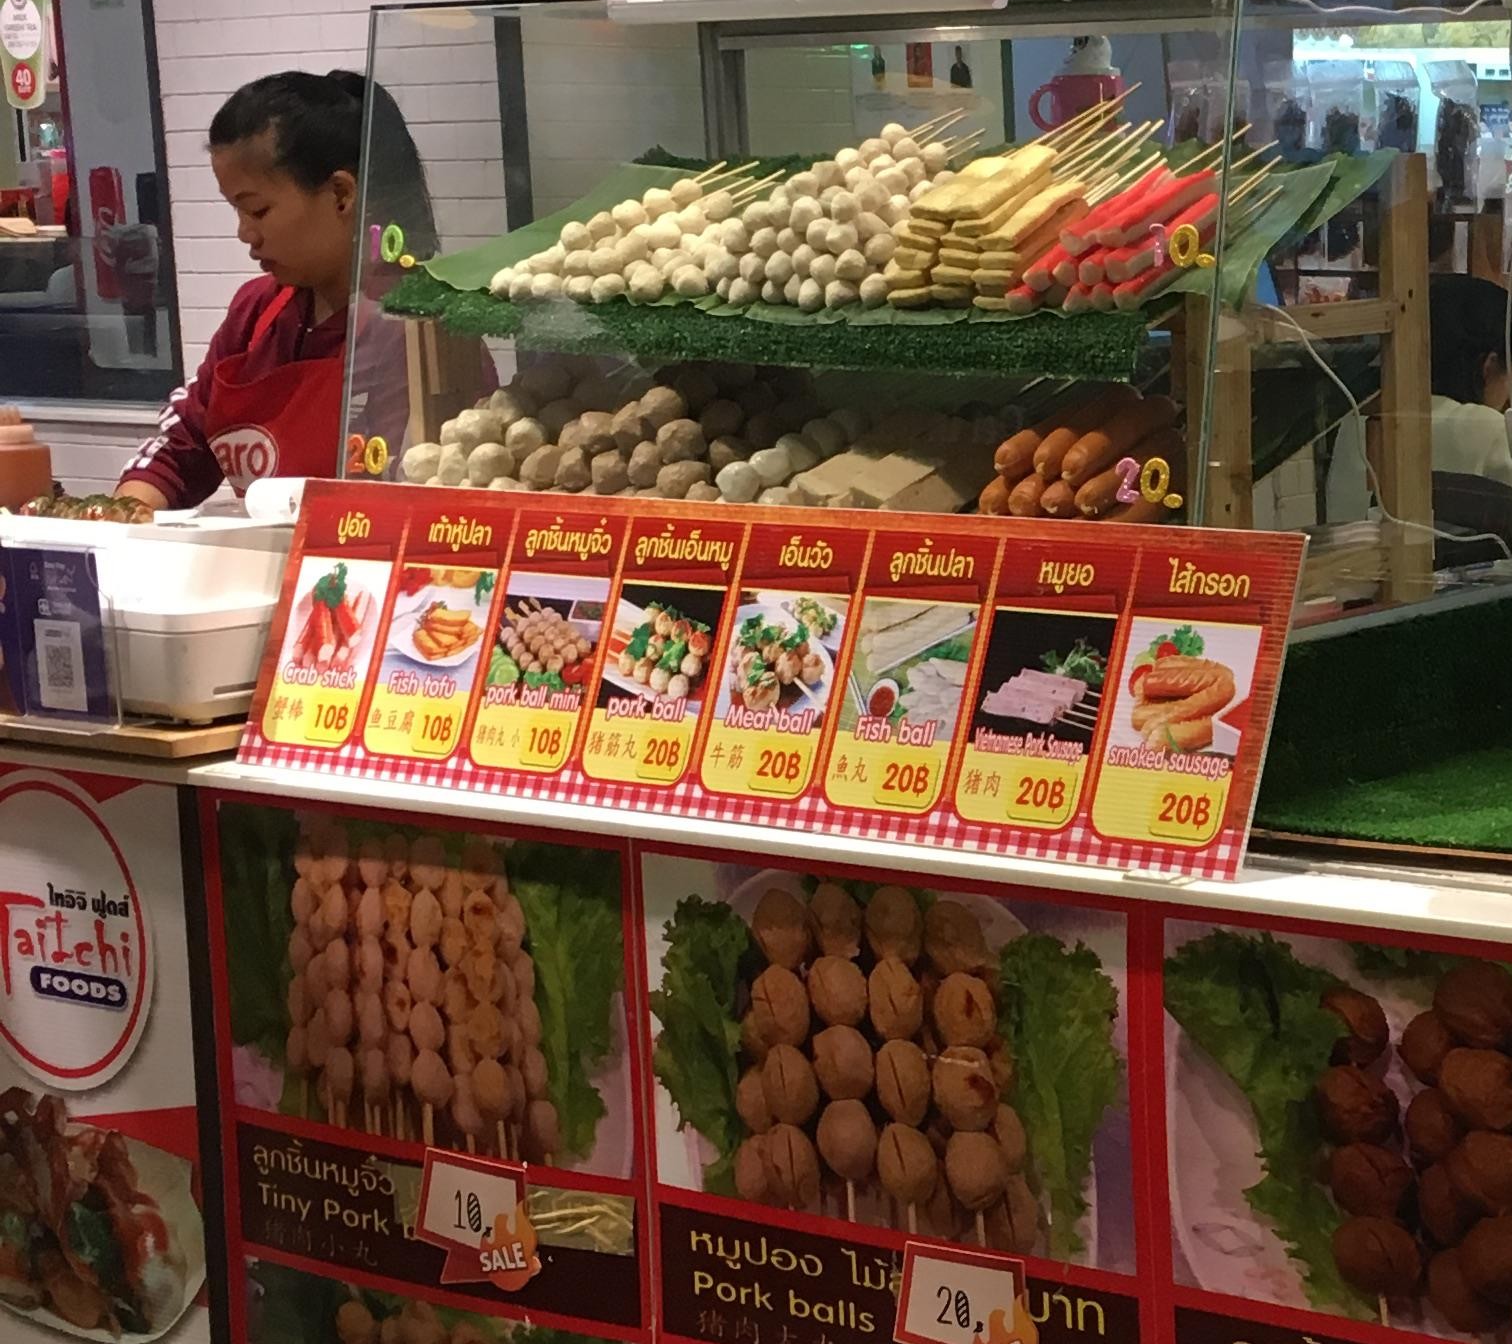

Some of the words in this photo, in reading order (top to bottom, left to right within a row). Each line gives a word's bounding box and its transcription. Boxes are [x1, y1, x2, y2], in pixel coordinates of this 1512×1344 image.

[15, 68, 32, 85] 40
[337, 511, 371, 546] ปูอัด
[427, 513, 493, 553] เต้าหู้ปลา
[525, 517, 613, 562] ลูกชิ้นหมูจิ๋ว
[634, 523, 735, 572] ลูกชิ้นเอ็นหมู
[778, 536, 834, 570] เอ็นวัว
[889, 540, 975, 586] ลูกชิ้นปลา
[1038, 559, 1095, 596] หมูยอ
[1168, 557, 1252, 599] ไส้กรอก
[283, 662, 318, 686] Crab
[321, 667, 357, 690] stick
[388, 672, 418, 695] Fish
[423, 676, 456, 698] tofu
[485, 685, 517, 709] pork
[521, 689, 547, 709] ball
[551, 691, 581, 712] mini
[605, 696, 645, 720] pork
[653, 697, 687, 722] ball
[725, 705, 774, 730] Meat
[778, 708, 813, 734] ball
[856, 717, 892, 744] Fish
[897, 718, 937, 747] ball
[974, 727, 1024, 756] Vietnamese
[1025, 732, 1044, 759] Pork
[1047, 735, 1084, 766] Sausage
[1107, 743, 1166, 771] smoked
[1168, 751, 1230, 781] sausage
[40, 972, 121, 1002] FOODS
[258, 1182, 312, 1221] Tiny
[323, 1198, 391, 1236] Pork
[479, 1242, 527, 1273] SALE
[694, 1270, 774, 1312] Pork
[789, 1288, 877, 1334] balls
